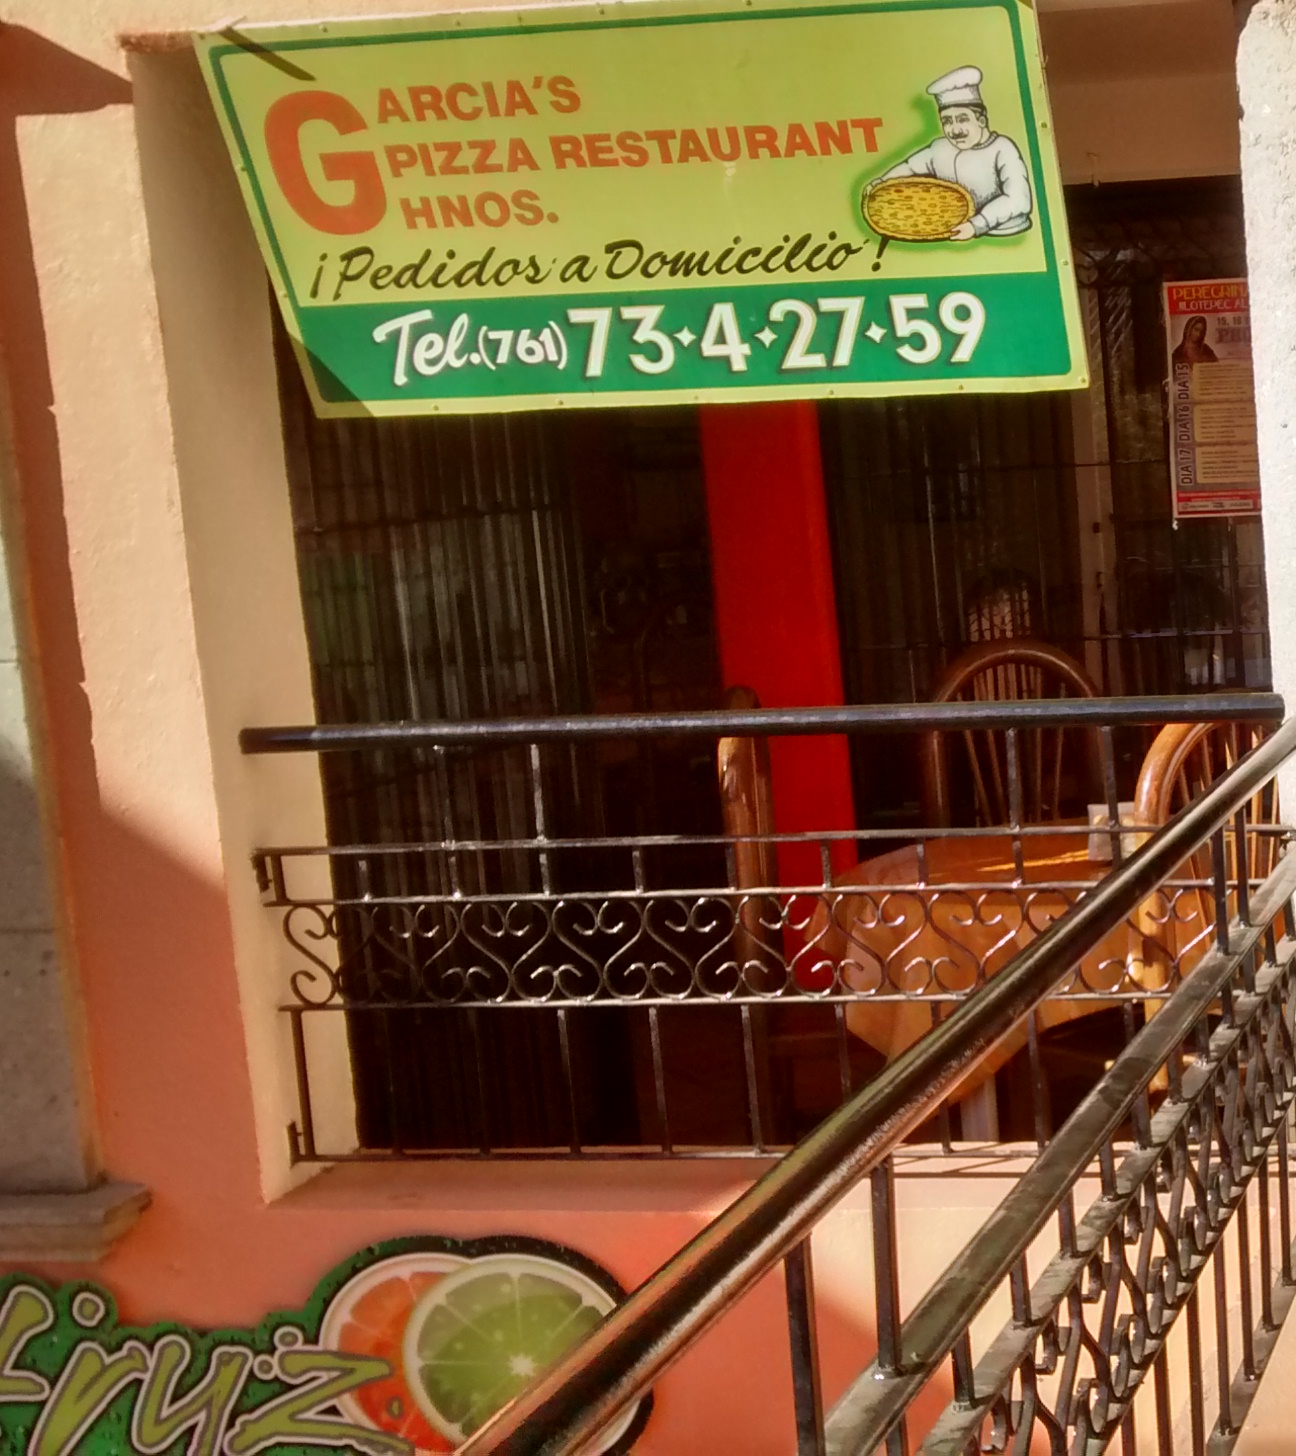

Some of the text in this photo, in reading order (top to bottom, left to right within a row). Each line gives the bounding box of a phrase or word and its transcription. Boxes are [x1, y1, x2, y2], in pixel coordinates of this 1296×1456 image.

[384, 117, 884, 178] PIZZA RESTAURANT
[399, 189, 560, 230] HNOS.
[558, 254, 598, 284] a
[1177, 364, 1190, 400] DIA 15
[1178, 405, 1191, 441] DIA 16
[1179, 449, 1193, 485] DIA 17
